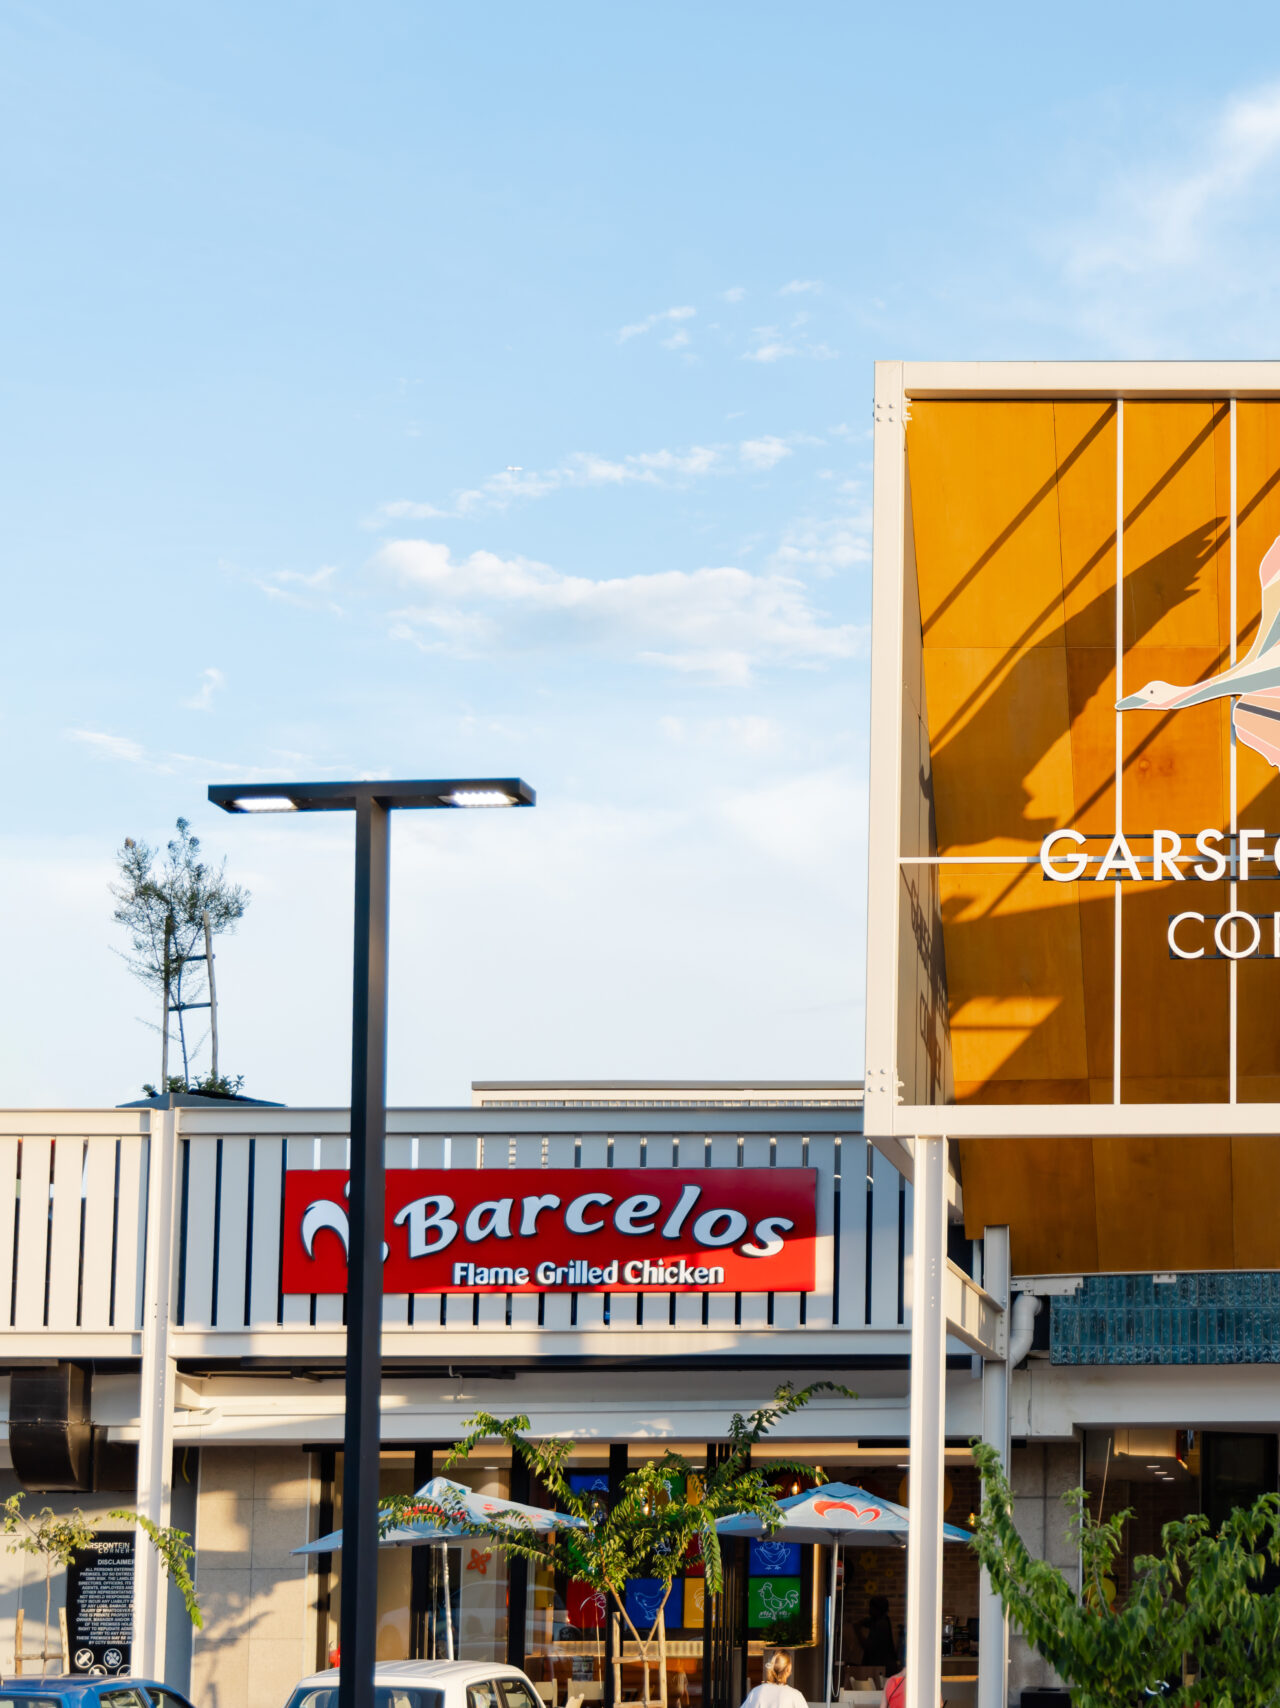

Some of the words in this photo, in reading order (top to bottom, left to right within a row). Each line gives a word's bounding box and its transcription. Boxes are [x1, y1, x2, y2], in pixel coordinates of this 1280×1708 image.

[394, 1184, 794, 1258] Barcelos
[453, 1262, 529, 1286] Flame
[536, 1259, 619, 1286] Grilled
[623, 1259, 725, 1286] Chicken
